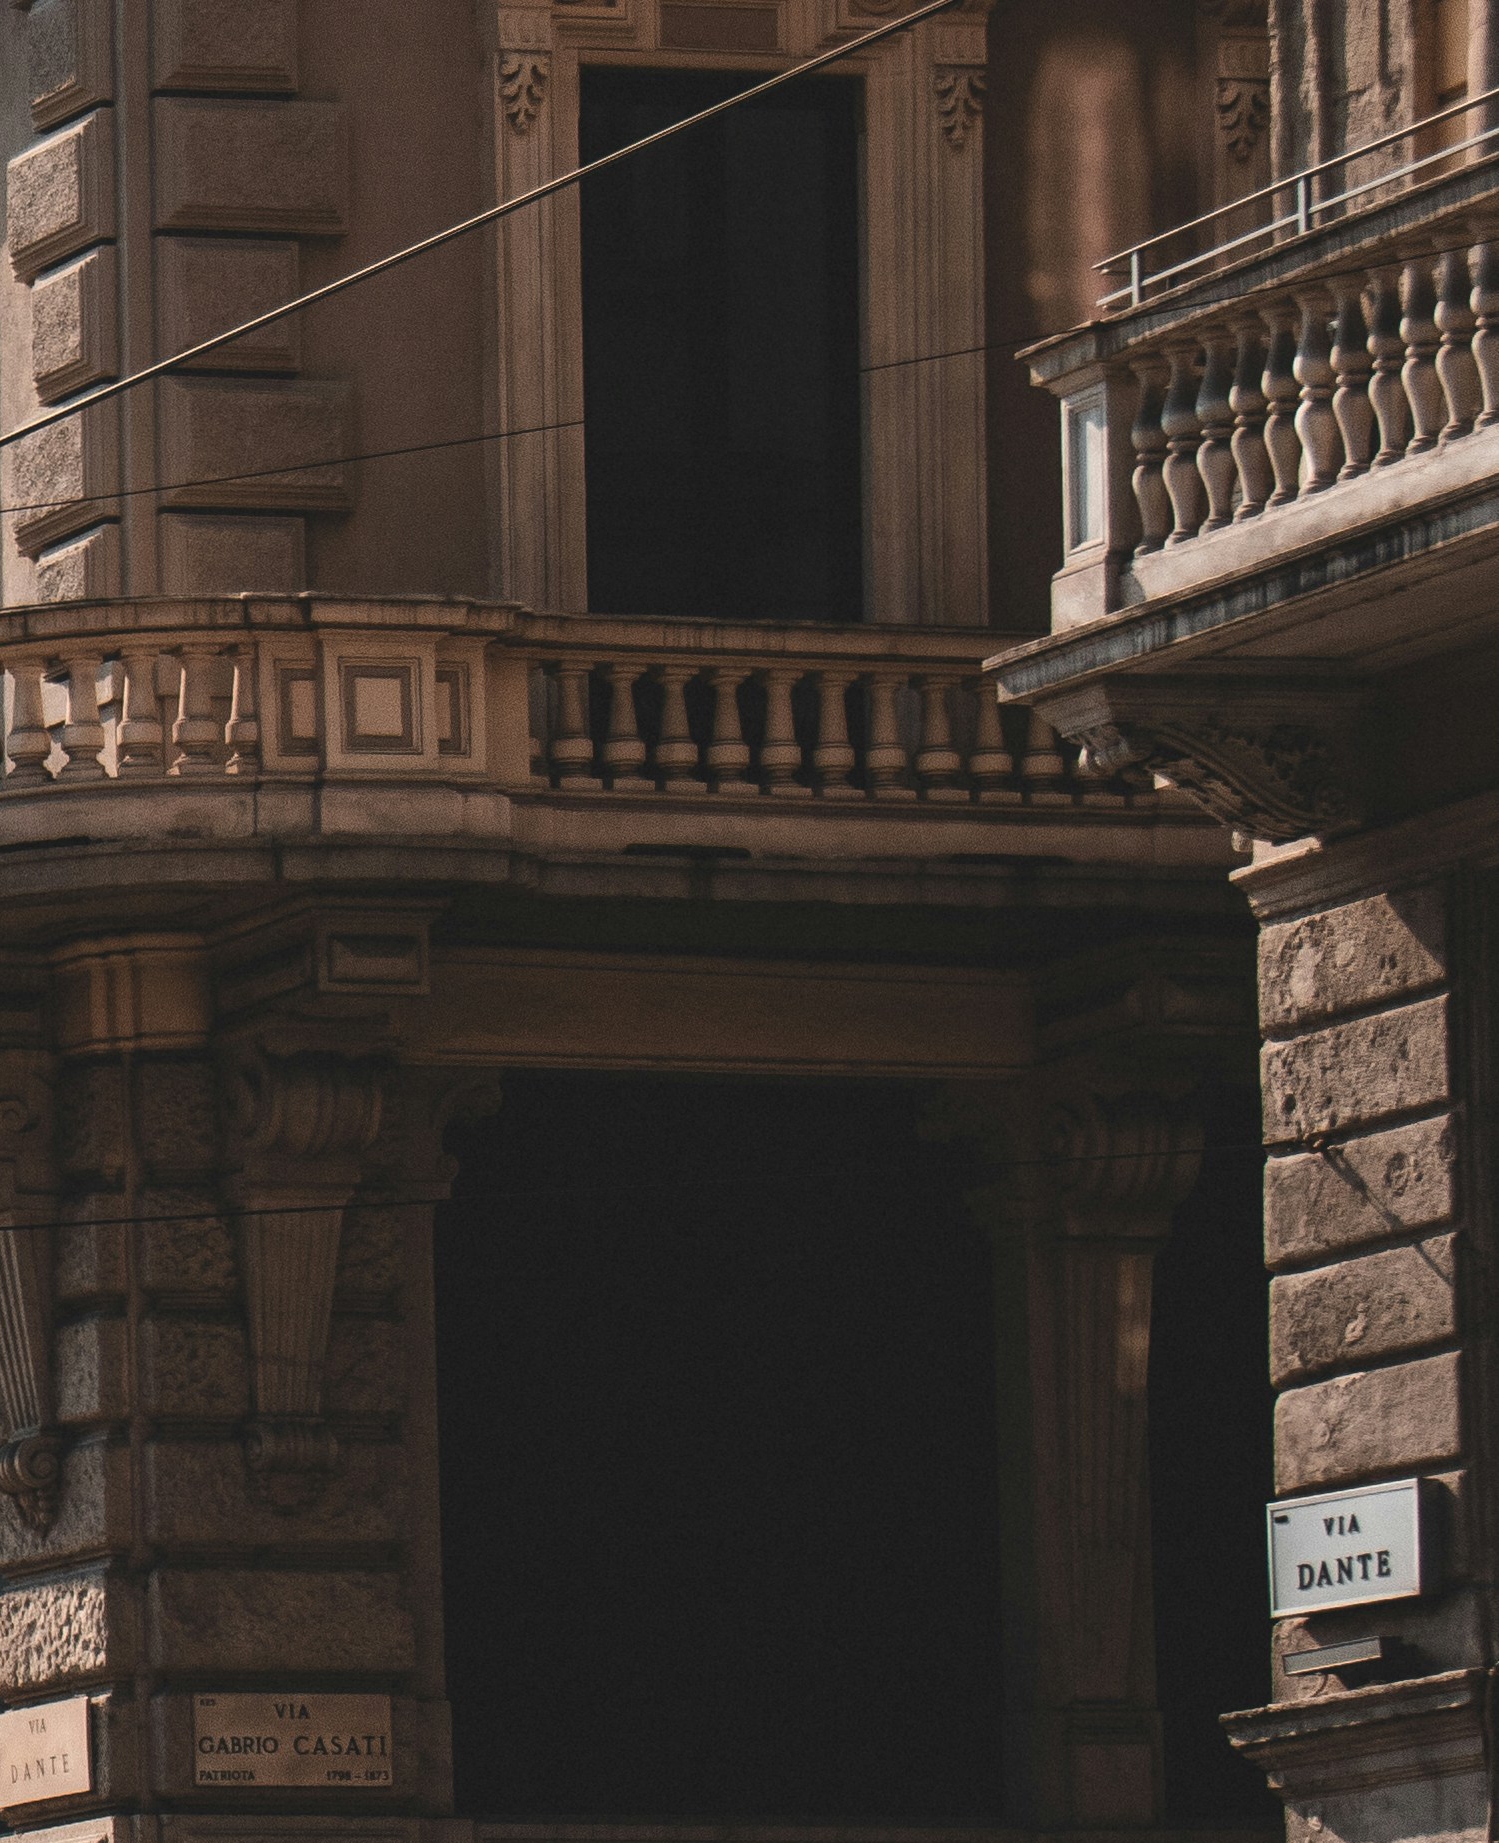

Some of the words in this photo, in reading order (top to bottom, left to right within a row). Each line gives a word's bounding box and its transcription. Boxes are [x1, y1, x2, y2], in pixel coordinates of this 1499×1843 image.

[1321, 1513, 1360, 1537] VIA
[1296, 1550, 1391, 1591] DANTE
[274, 1702, 311, 1721] VIA
[28, 1717, 48, 1735] VIA
[197, 1735, 279, 1755] GABRIO
[293, 1735, 388, 1757] CASATI
[10, 1753, 71, 1784] DANTE
[198, 1769, 256, 1781] PATRIOTA
